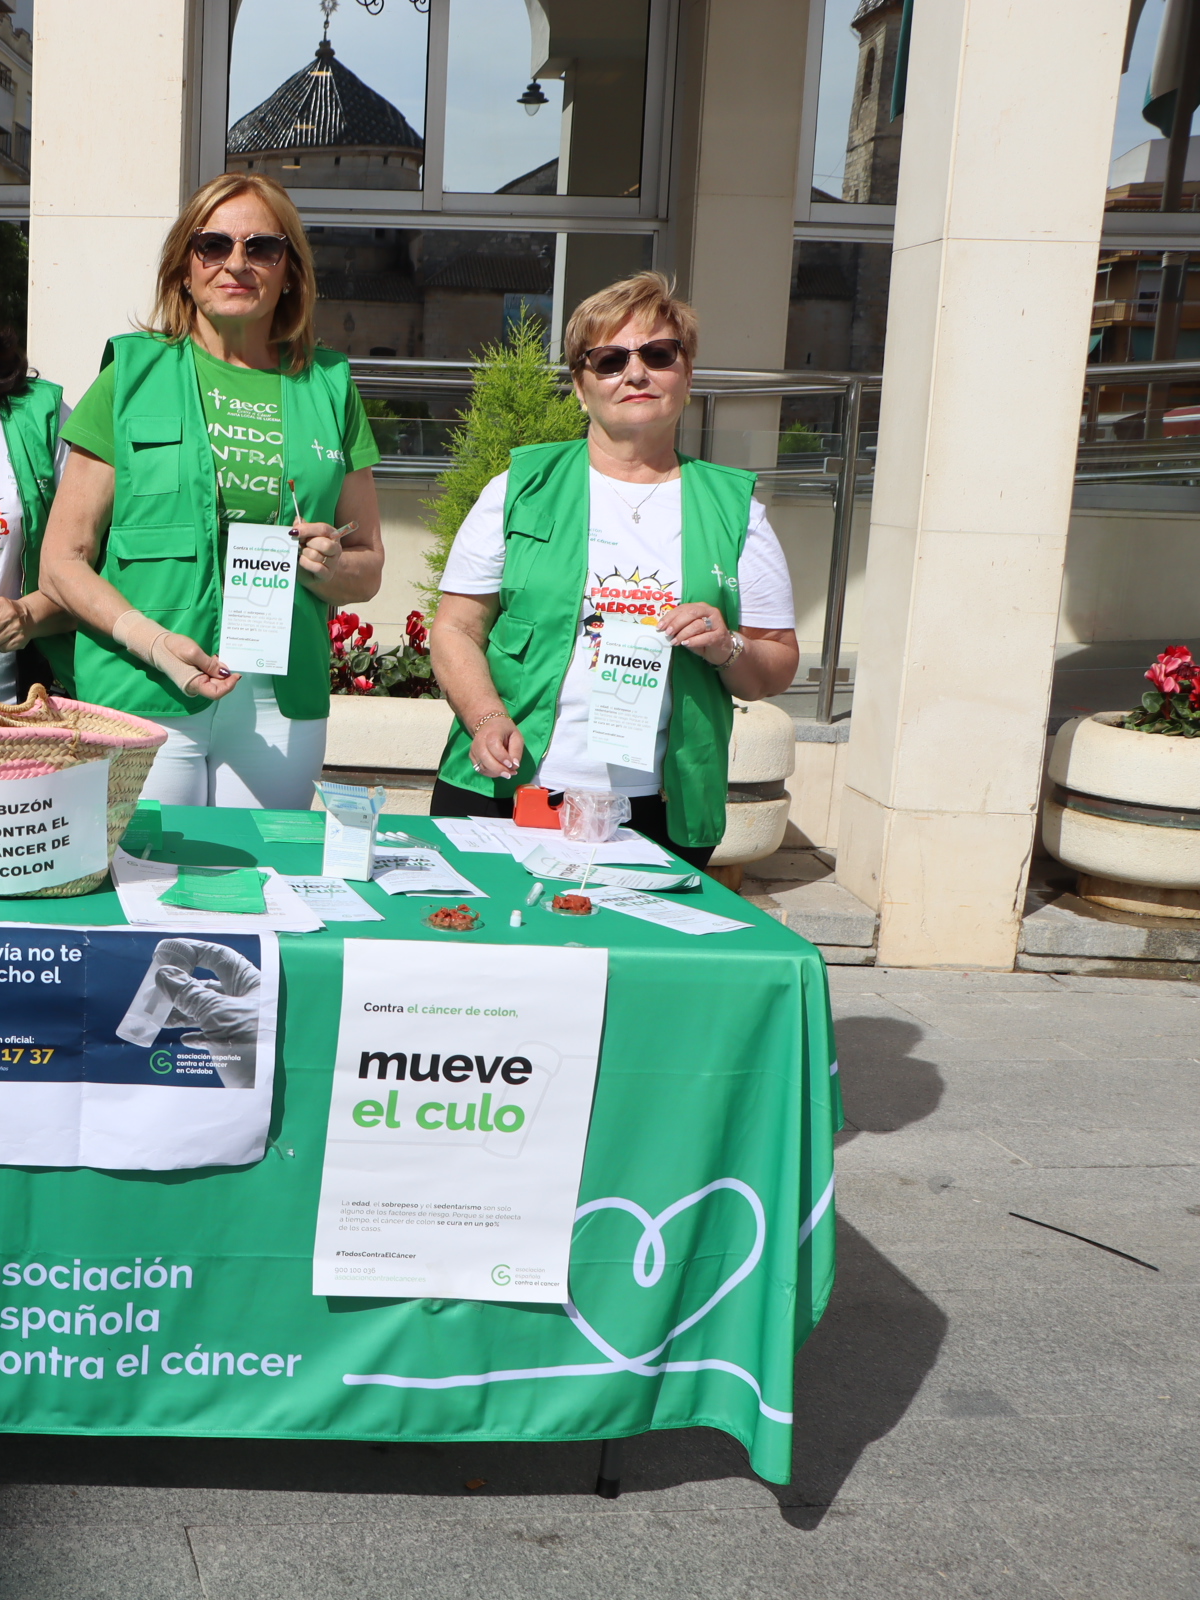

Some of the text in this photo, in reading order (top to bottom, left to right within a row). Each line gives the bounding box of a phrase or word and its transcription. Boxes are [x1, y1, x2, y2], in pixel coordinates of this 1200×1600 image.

[230, 398, 277, 413] aecc
[208, 423, 283, 445] NIDO
[211, 444, 283, 468] NTRA
[233, 558, 290, 572] mueve
[231, 572, 289, 589] el culo
[590, 586, 674, 602] PEQUEÑOS
[604, 654, 661, 671] mueve
[601, 668, 658, 688] el culo
[52, 816, 69, 830] EL
[51, 834, 70, 850] DE
[0, 860, 54, 878] COLON
[28, 948, 54, 962] no
[60, 944, 82, 962] te
[41, 966, 61, 984] el
[363, 1002, 519, 1018] Contra el cáncer de colon,
[4, 1036, 35, 1044] oficial:
[1, 1048, 24, 1064] 17
[29, 1048, 55, 1064] 37
[358, 1051, 532, 1085] mueve
[352, 1089, 525, 1133] el culo
[434, 1203, 482, 1211] sedentarismo
[336, 1251, 416, 1260] #TodosContraElCáncer
[116, 1344, 148, 1375] el
[160, 1343, 302, 1377] cáncer
